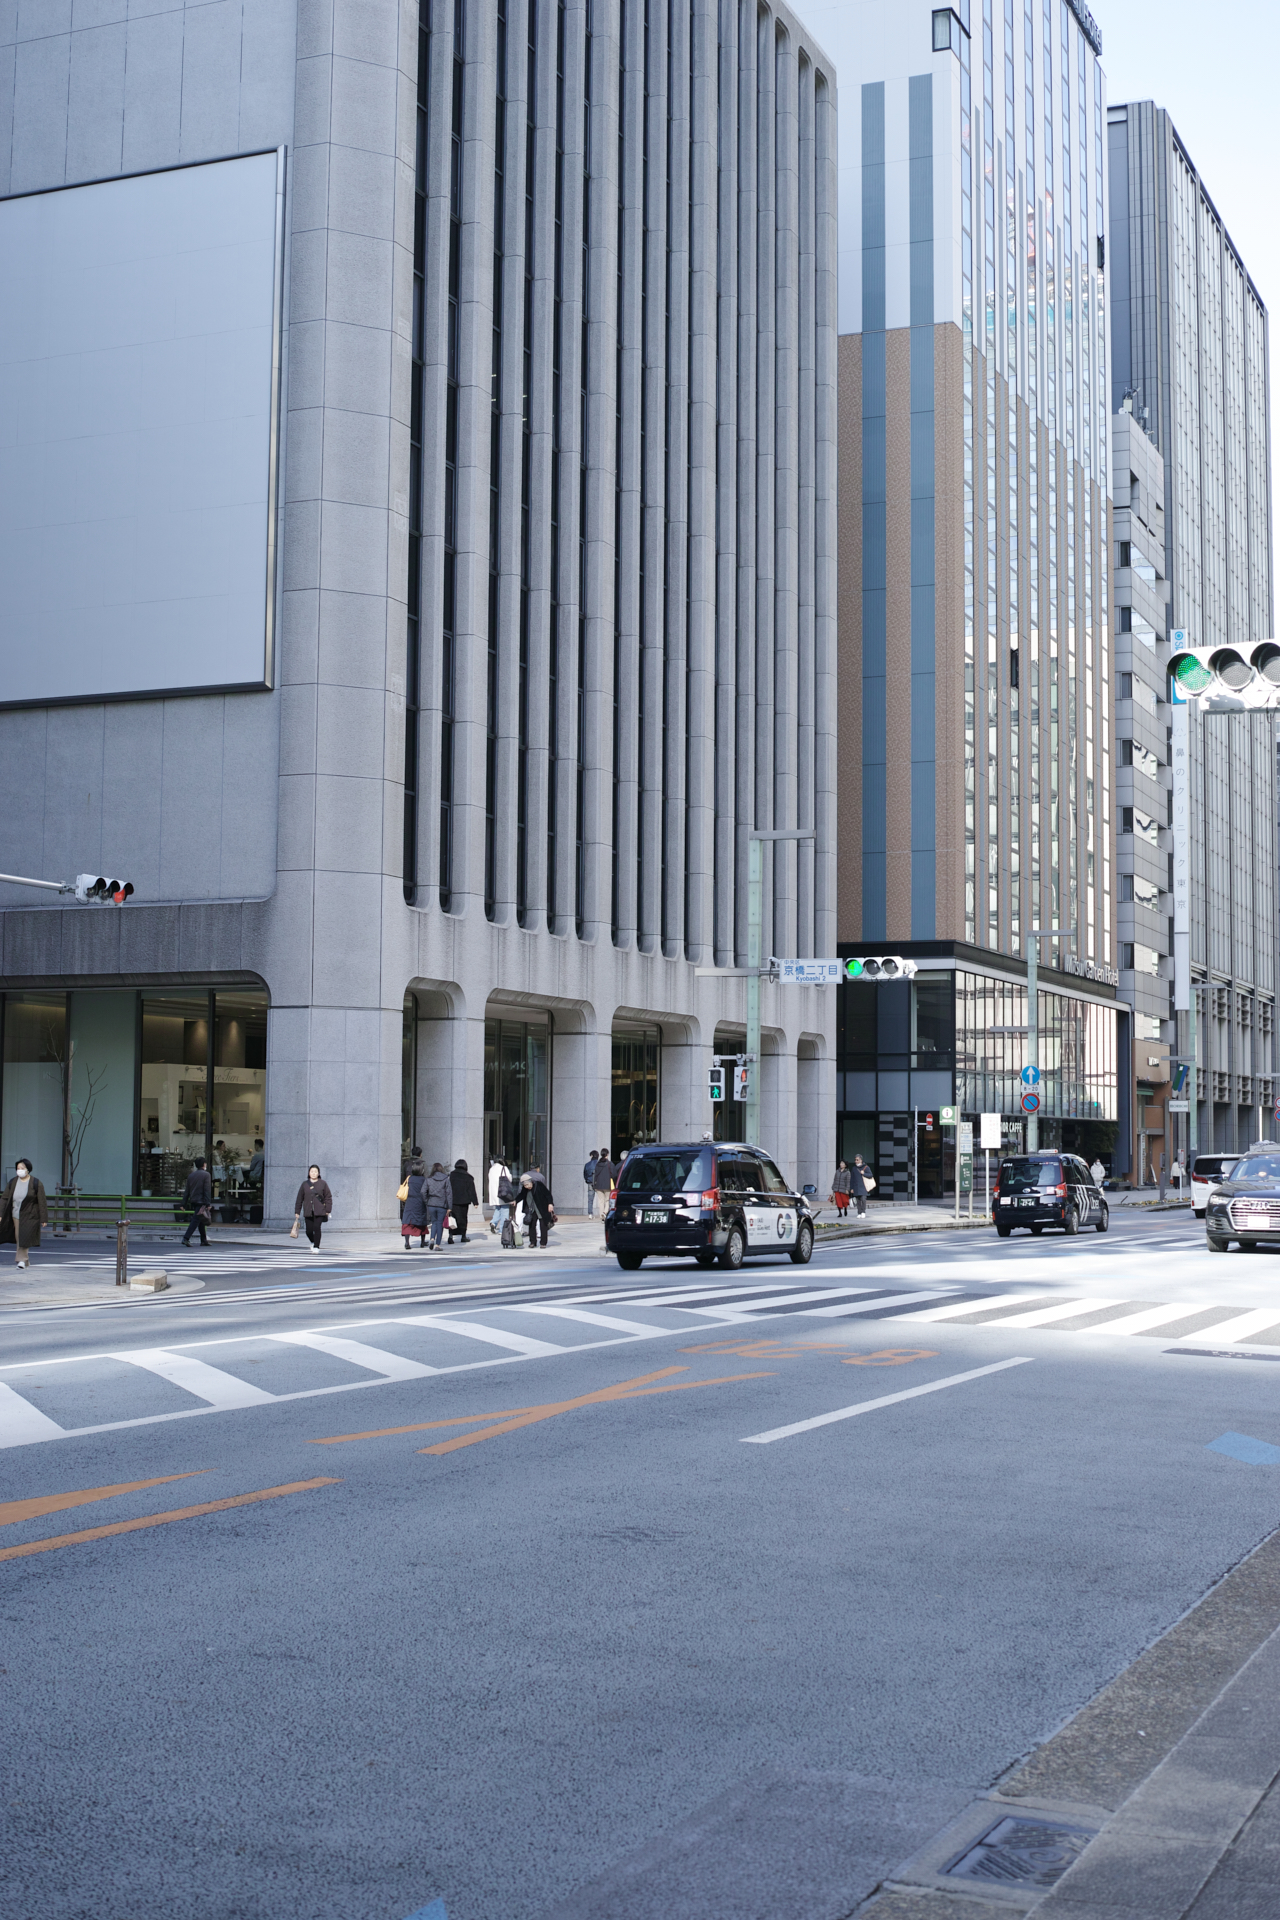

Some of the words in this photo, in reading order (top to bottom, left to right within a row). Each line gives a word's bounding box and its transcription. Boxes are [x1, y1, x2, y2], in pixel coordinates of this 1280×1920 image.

[1175, 748, 1186, 909] 鼻のクリニック東京
[784, 965, 838, 976] 京橋二丁目
[1104, 965, 1119, 987] Hotel
[1090, 1196, 1099, 1209] Uber
